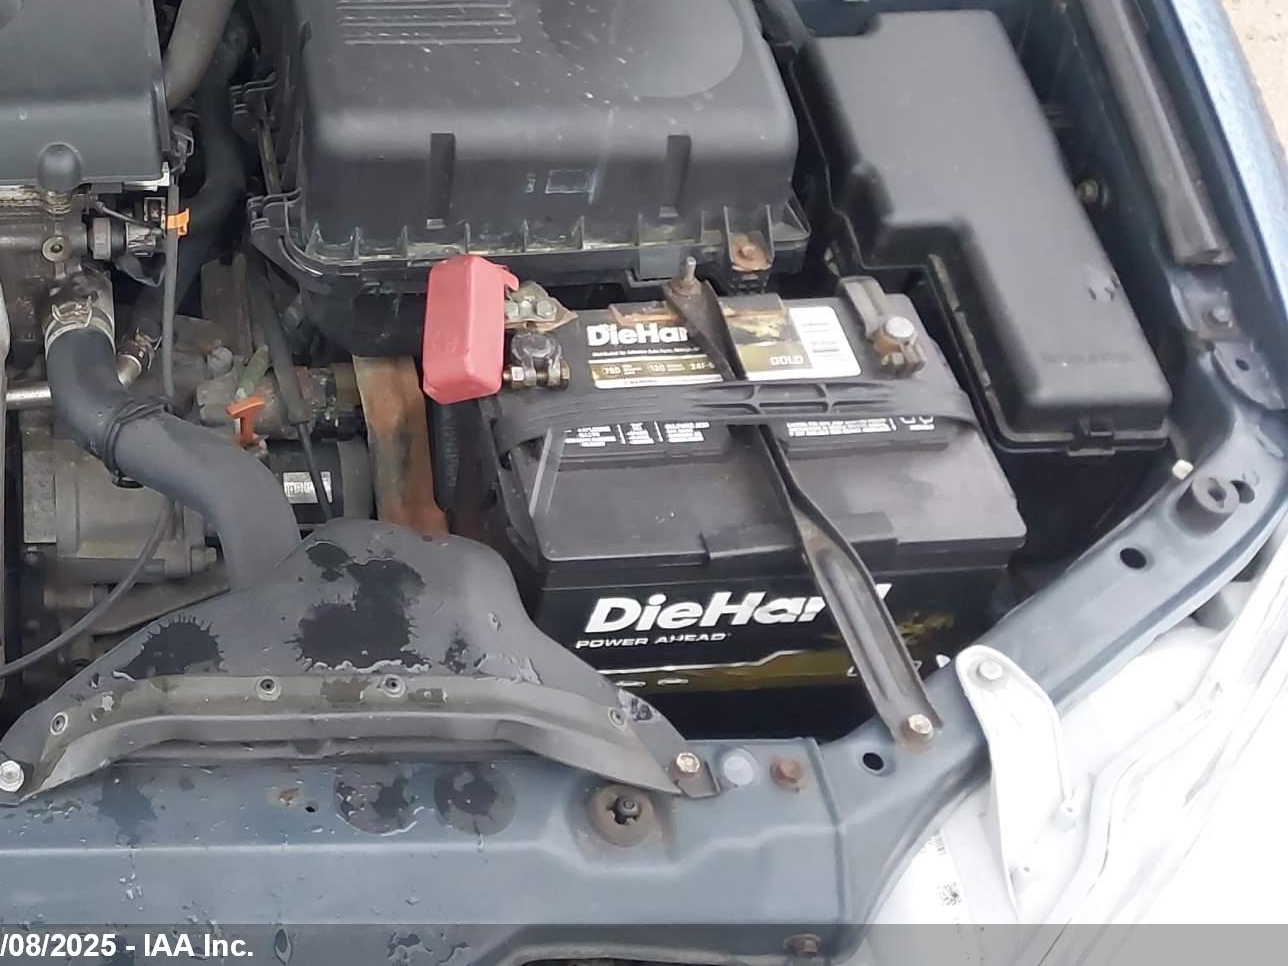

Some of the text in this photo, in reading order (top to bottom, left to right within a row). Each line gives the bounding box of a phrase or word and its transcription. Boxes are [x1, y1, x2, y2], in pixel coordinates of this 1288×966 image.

[586, 322, 689, 347] DieHar
[770, 355, 804, 365] GOLD
[585, 583, 892, 634] DieHar
[575, 632, 727, 650] POWER AHEAD
